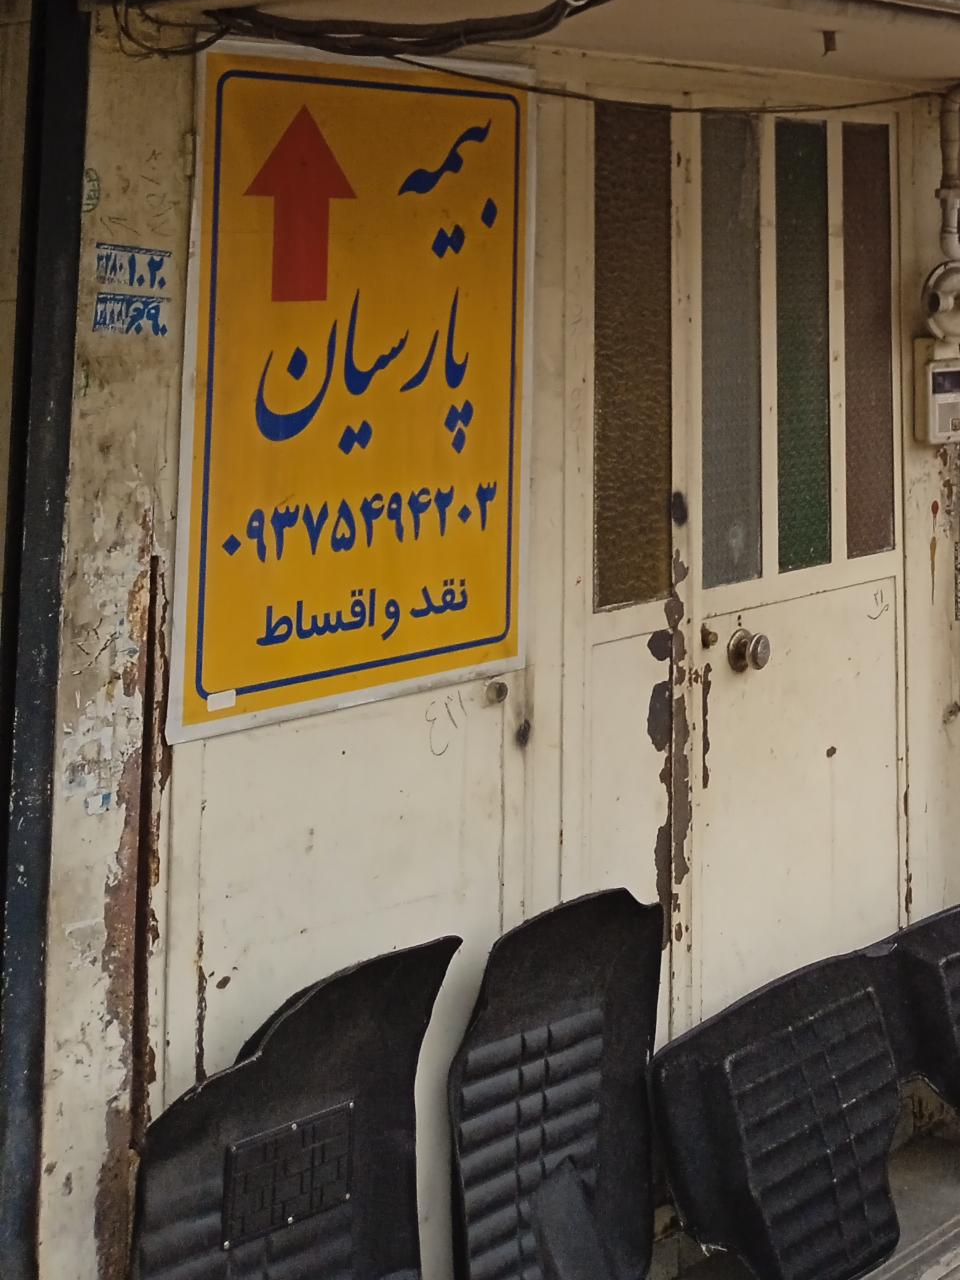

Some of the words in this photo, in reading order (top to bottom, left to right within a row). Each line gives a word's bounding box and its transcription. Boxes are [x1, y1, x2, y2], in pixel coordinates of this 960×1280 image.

[397, 117, 499, 260] بیمه
[254, 285, 475, 456] پارسیان
[221, 479, 498, 565] ۰۹۳۷۵۴۹۴۲۰۳
[256, 587, 379, 648] اقساط
[383, 603, 401, 641] و
[409, 577, 470, 619] نقد
